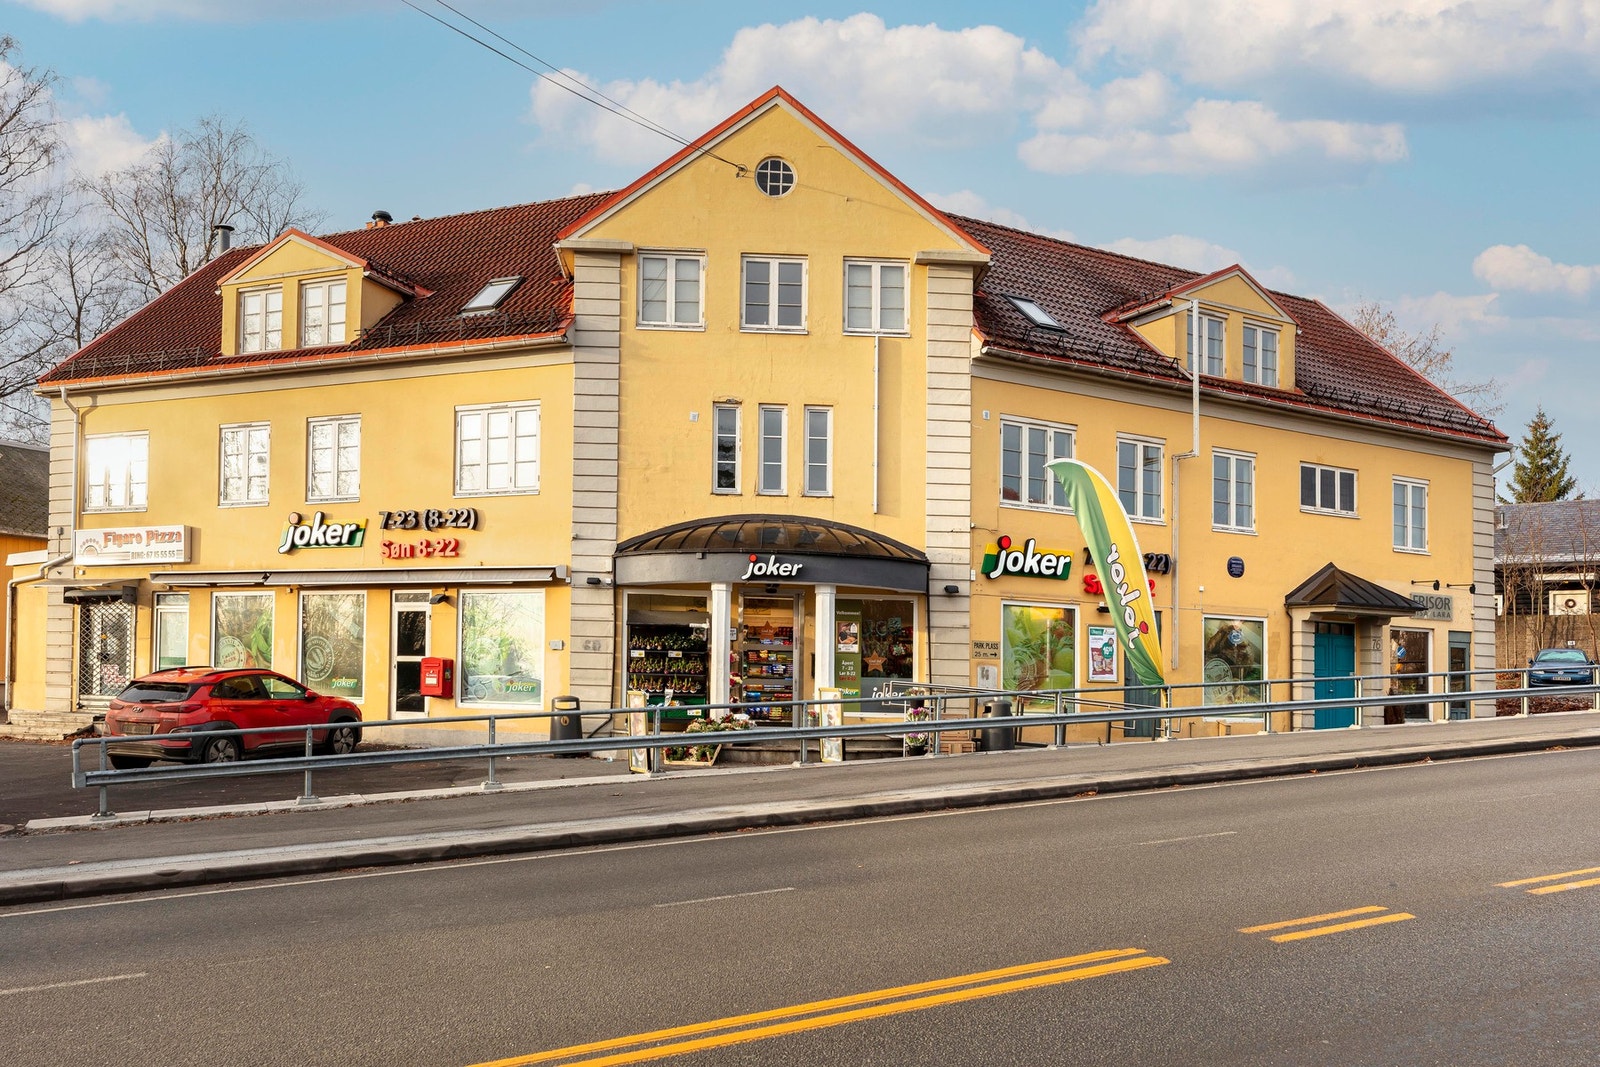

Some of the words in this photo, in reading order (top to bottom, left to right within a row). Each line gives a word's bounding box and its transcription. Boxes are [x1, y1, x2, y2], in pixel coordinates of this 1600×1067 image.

[379, 509, 419, 530] 7-23
[422, 507, 478, 532] (8-22)
[103, 531, 143, 548] Figaro
[145, 530, 182, 547] Pizza
[278, 511, 359, 554] joker
[380, 540, 414, 559] Søn
[418, 537, 460, 558] 8-22
[985, 535, 1071, 579] joker
[741, 553, 803, 580] joker
[1372, 639, 1381, 650] 76
[332, 677, 355, 688] joker
[508, 680, 533, 693] joker
